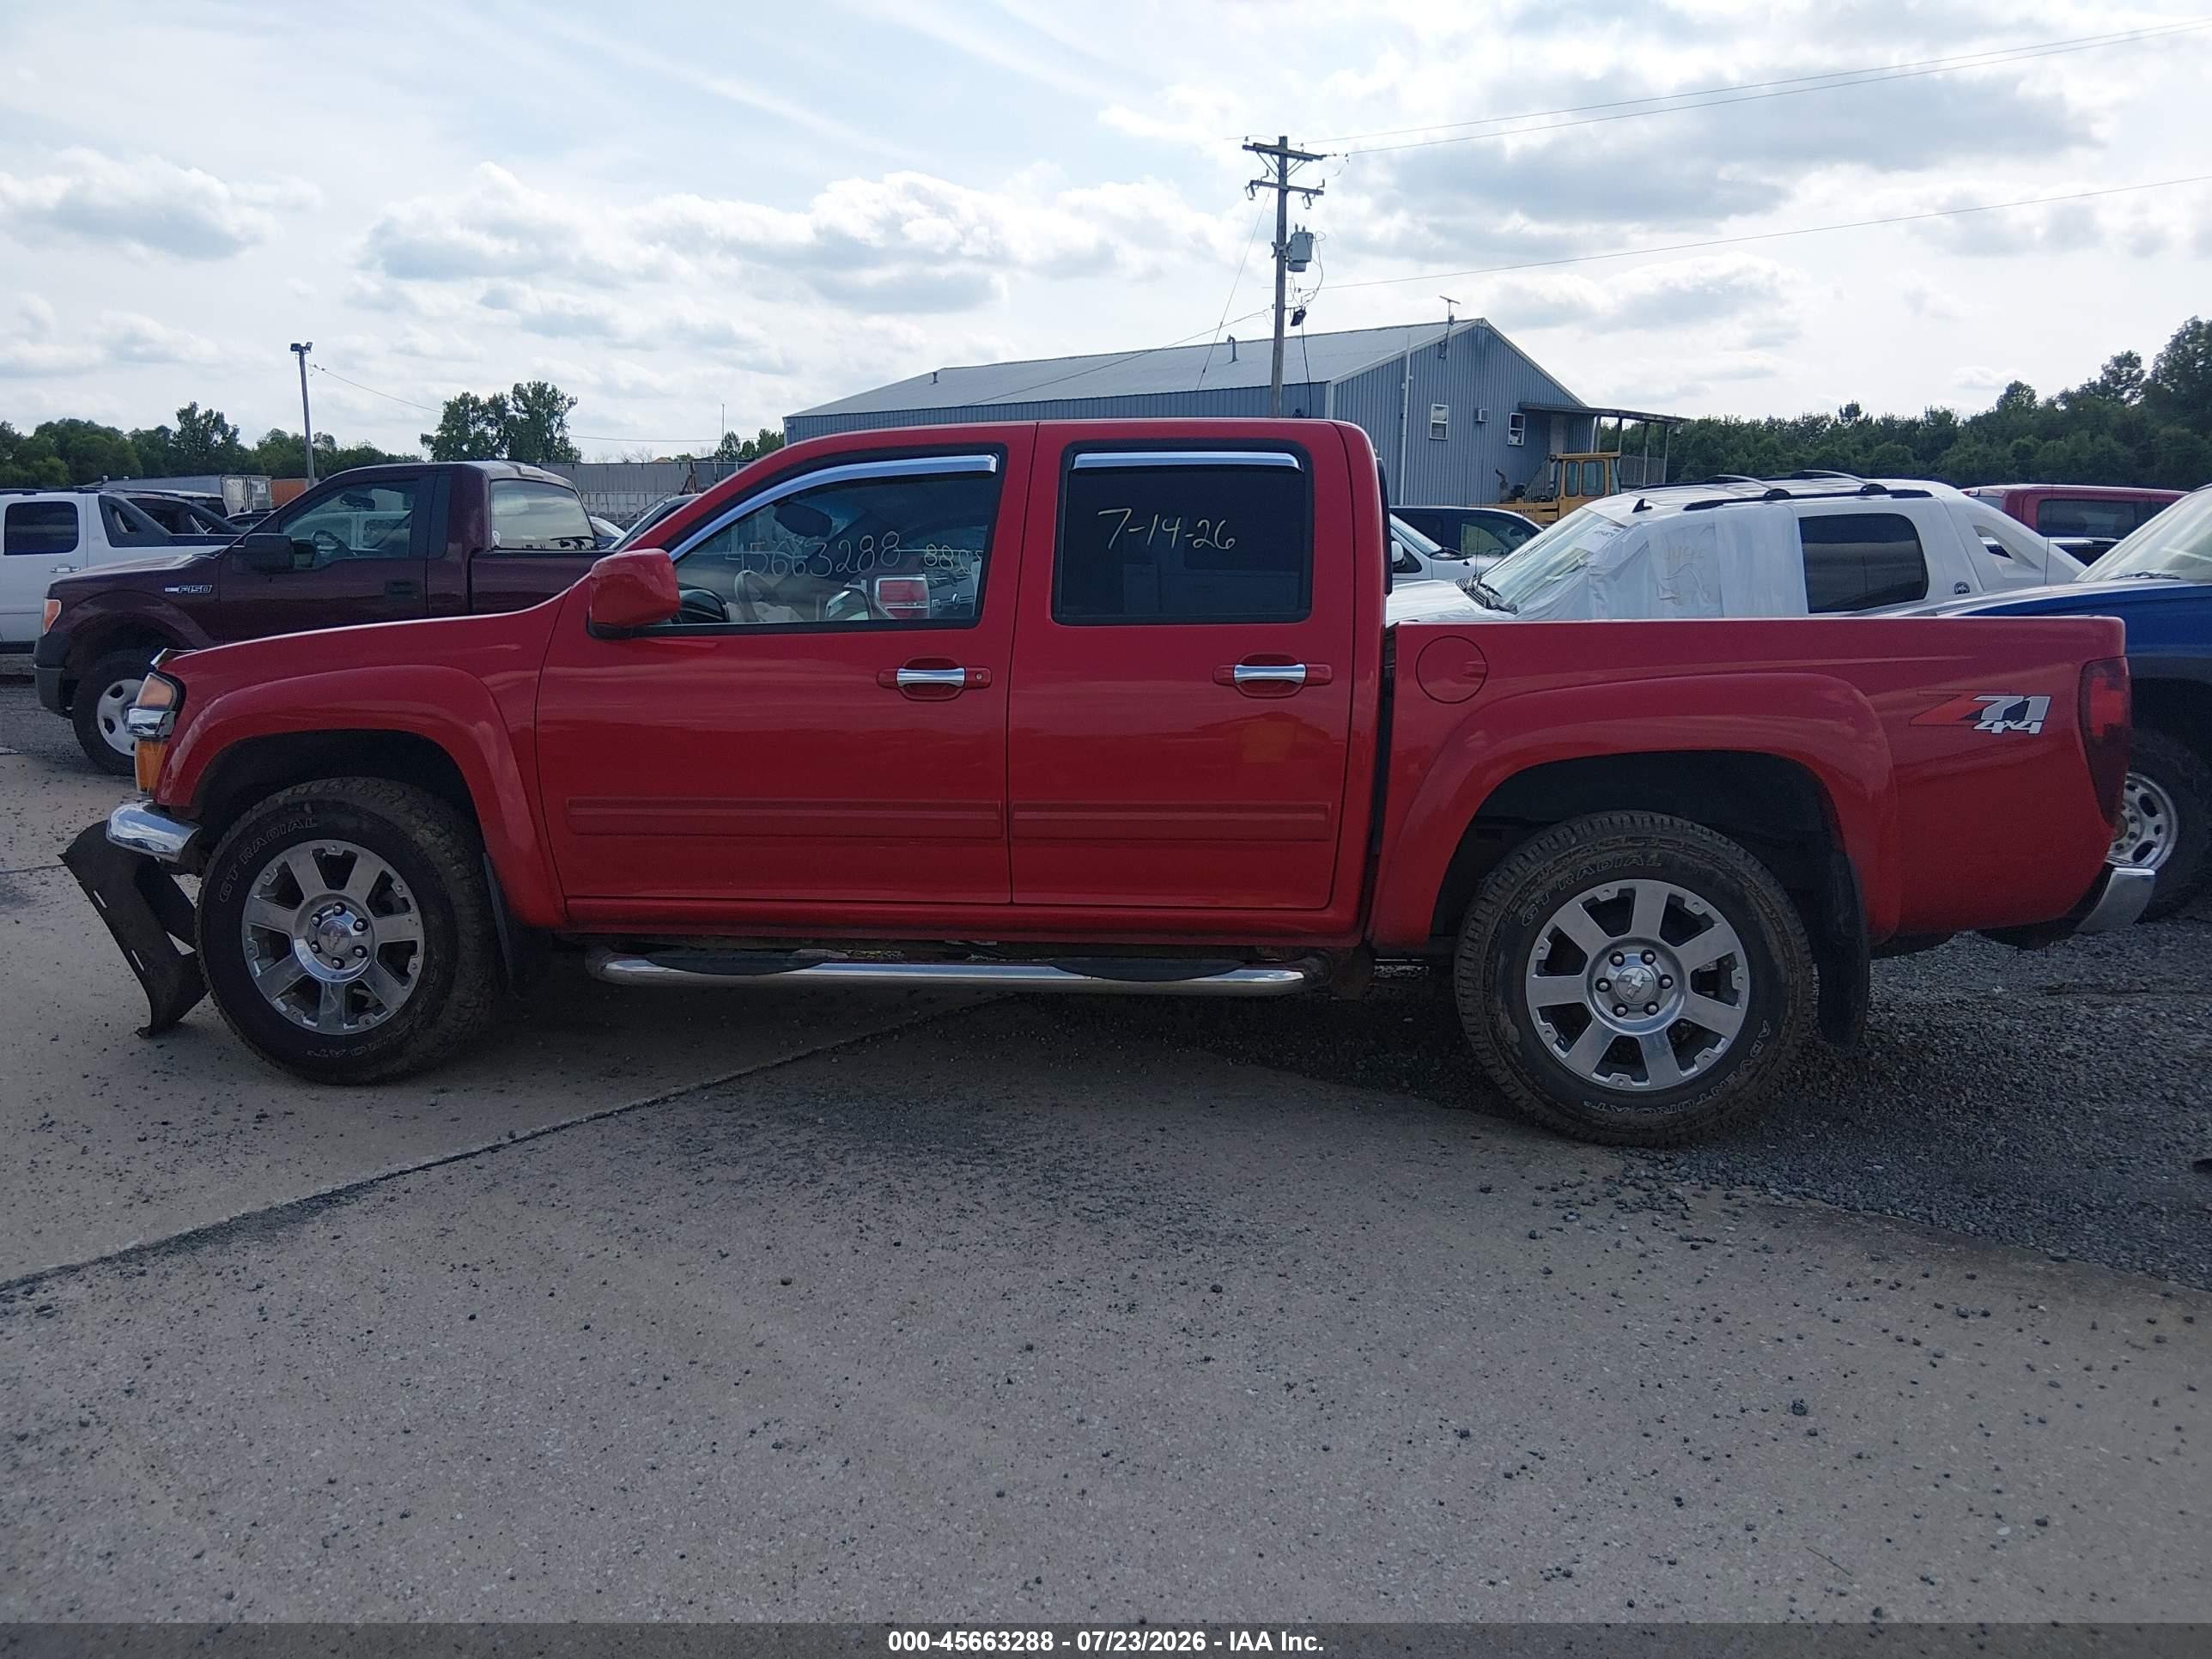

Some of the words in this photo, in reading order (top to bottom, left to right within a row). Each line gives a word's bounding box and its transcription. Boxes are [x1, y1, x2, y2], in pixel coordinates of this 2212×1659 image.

[1097, 507, 1236, 550] 7-14-26
[725, 530, 901, 578] 45663288
[1909, 689, 2053, 727] Z71
[239, 817, 318, 865] RADIAL
[1558, 853, 1663, 893] RADIAL
[1637, 1019, 1771, 1117] ADVENTURO
